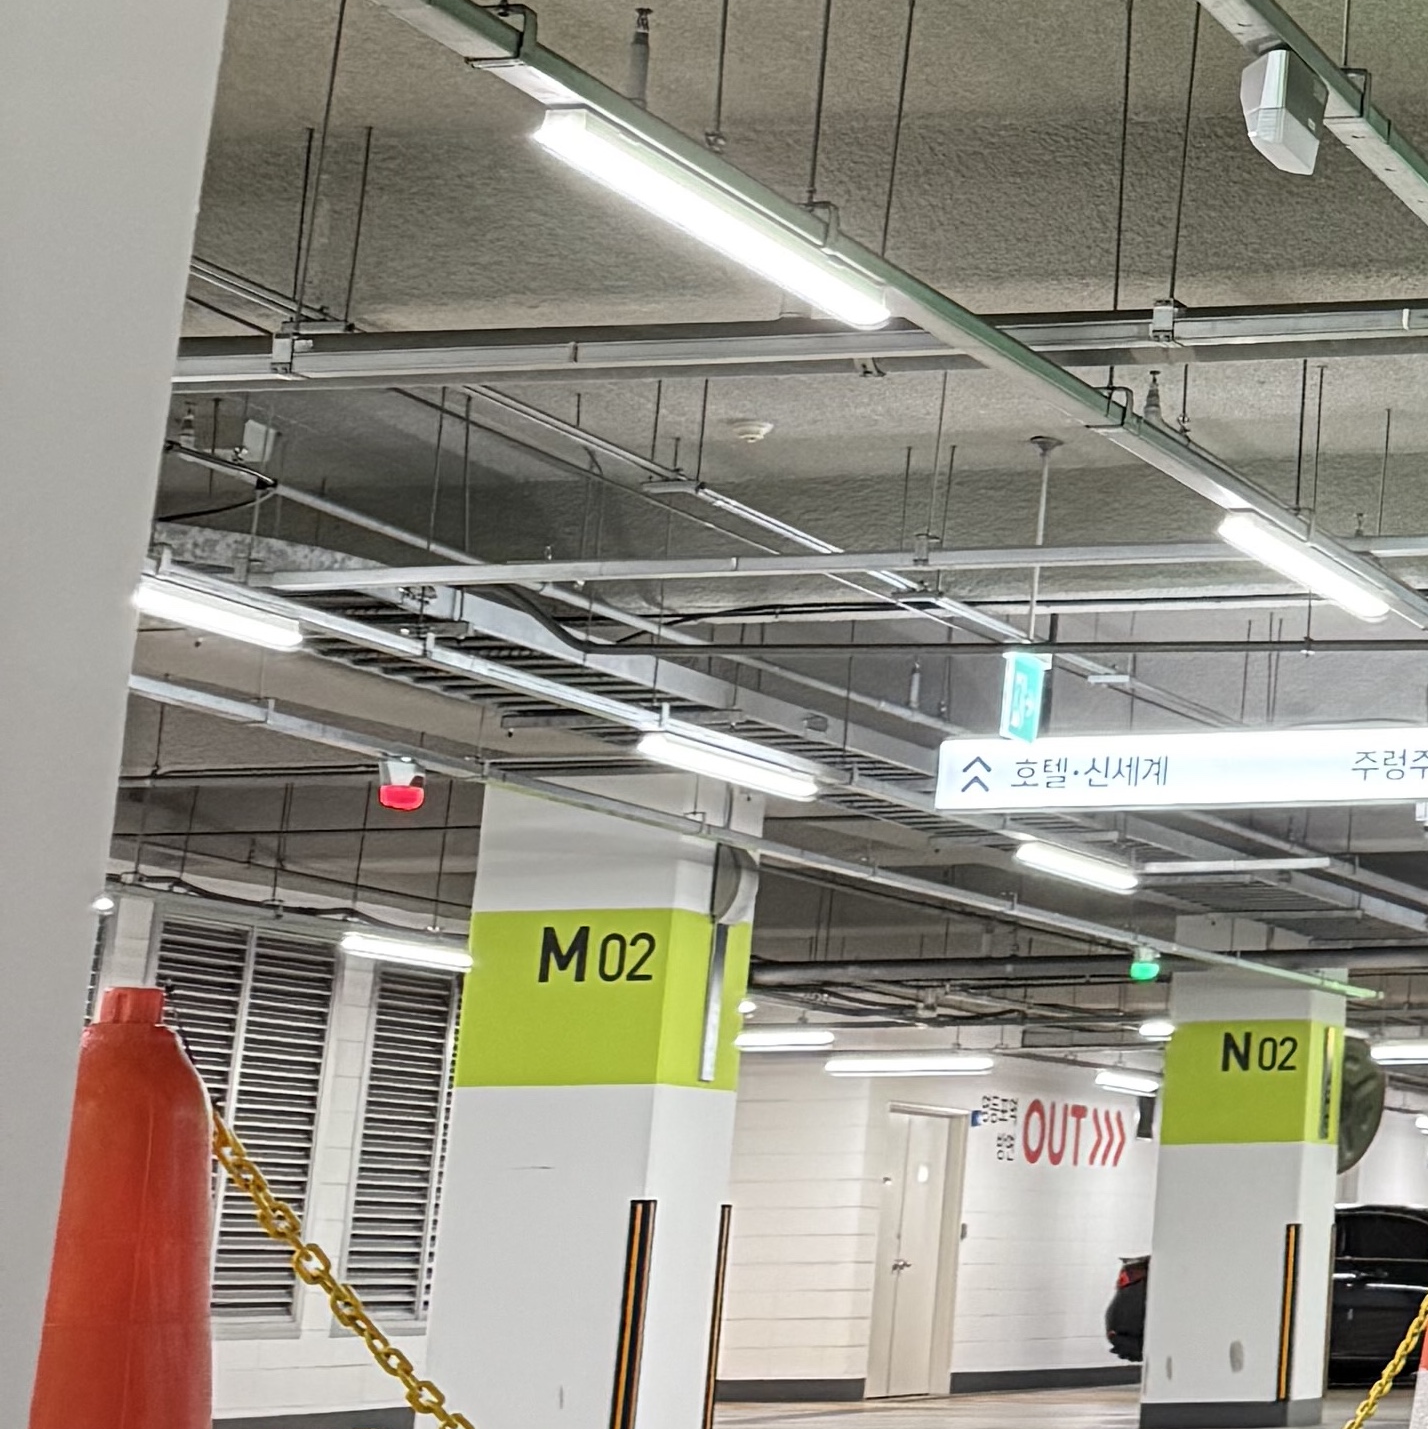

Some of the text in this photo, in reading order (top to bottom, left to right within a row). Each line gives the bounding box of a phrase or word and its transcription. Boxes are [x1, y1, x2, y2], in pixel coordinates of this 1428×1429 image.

[1011, 755, 1168, 788] 호텔·신세계
[538, 925, 656, 982] M 02
[1222, 1032, 1298, 1072] N 02
[1022, 1098, 1088, 1166] OUT
